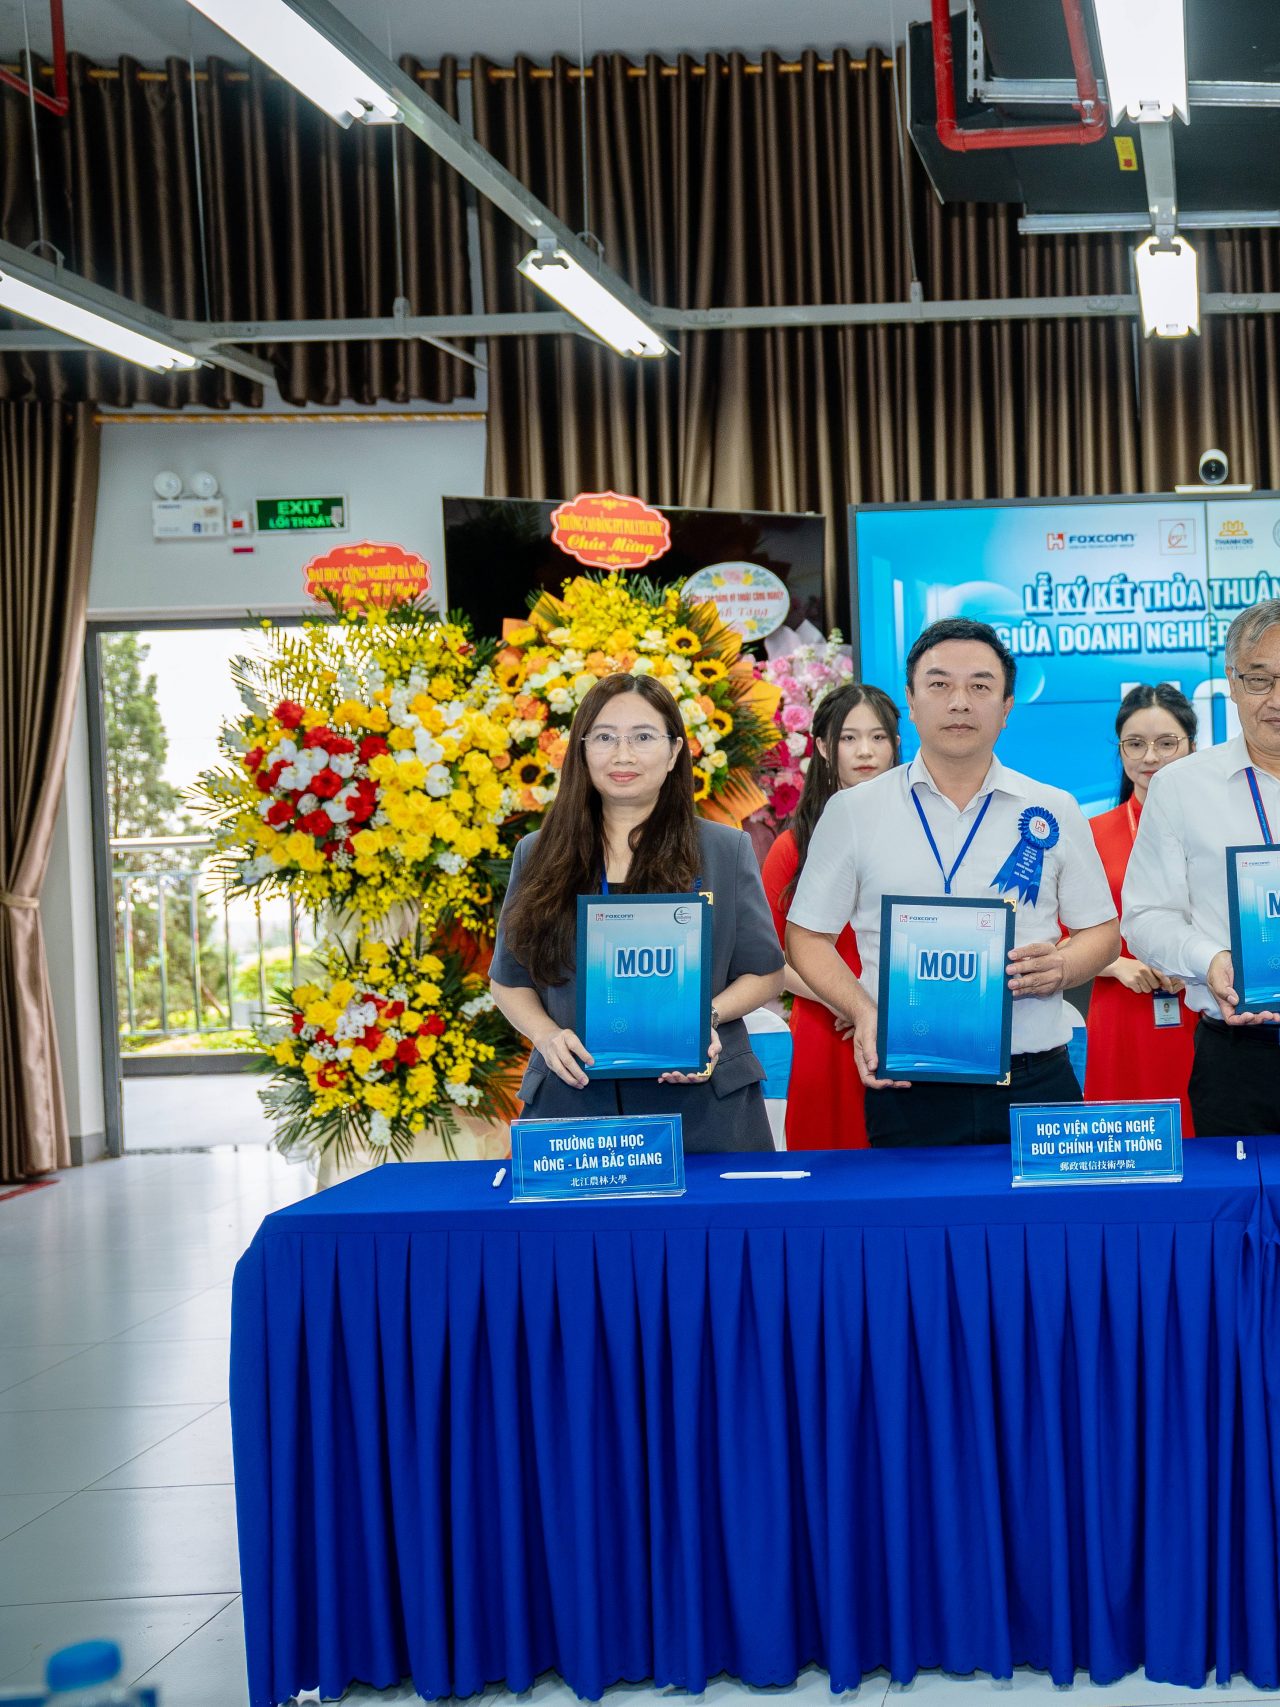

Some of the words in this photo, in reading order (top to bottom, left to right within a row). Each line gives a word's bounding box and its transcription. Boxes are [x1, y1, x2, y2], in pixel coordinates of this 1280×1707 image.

[277, 500, 323, 515] EXIT
[269, 514, 291, 529] LỐI
[567, 534, 607, 550] Chúc
[609, 537, 654, 555] Mừng
[1069, 533, 1135, 544] FOXCONN
[1025, 573, 1051, 613] LỄ
[1056, 576, 1088, 612] KÝ
[1094, 573, 1136, 611] KẾT
[1140, 573, 1204, 609] THỎA
[1000, 619, 1052, 654] GIỮA
[1057, 624, 1140, 652] DOANH
[1146, 613, 1230, 654] NGHIỆP
[616, 948, 672, 976] MOU
[919, 951, 975, 979] MOU
[1037, 1123, 1061, 1139] HỌC
[1063, 1120, 1088, 1139] VIỆN
[1091, 1118, 1122, 1134] CÔNG
[1125, 1117, 1156, 1135] NGHỆ
[549, 1134, 595, 1152] TRƯỜNG
[598, 1136, 617, 1151] ĐẠI
[620, 1134, 644, 1148] HỌC
[1031, 1141, 1055, 1156] BƯU
[1058, 1138, 1094, 1155] CHÍNH
[1097, 1135, 1122, 1153] VIỄN
[1124, 1135, 1162, 1152] THÔNG
[533, 1155, 564, 1172] NÔNG
[576, 1155, 599, 1170] LÂM
[602, 1150, 625, 1168] BẮC
[628, 1152, 662, 1166] GIANG
[1059, 1159, 1136, 1171] 郵政電信技術學院
[570, 1174, 628, 1187] 北江農林大學
